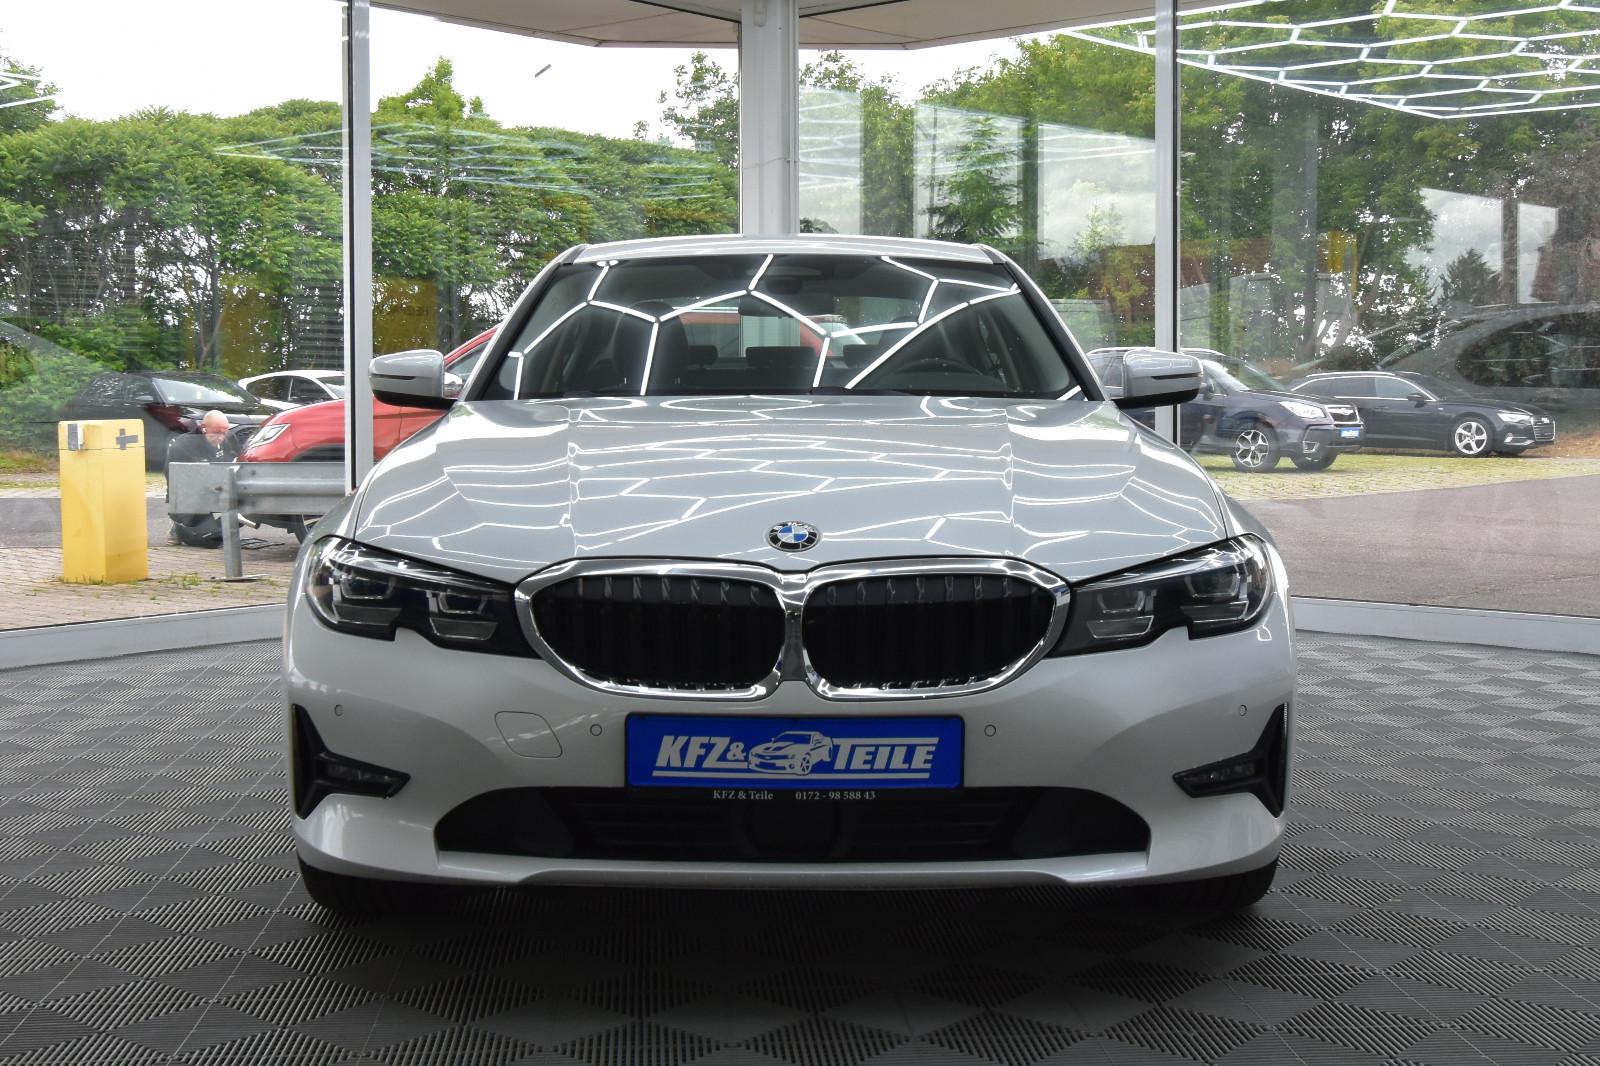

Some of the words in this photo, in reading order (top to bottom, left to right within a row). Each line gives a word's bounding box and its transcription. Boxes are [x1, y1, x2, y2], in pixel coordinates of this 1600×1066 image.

[831, 737, 939, 770] TEILE
[713, 789, 735, 800] KFZ
[737, 790, 747, 800] &
[749, 790, 774, 800] Teile
[795, 791, 820, 800] 0172
[828, 791, 841, 800] 98
[843, 791, 862, 800] 588
[863, 791, 876, 800] 43
